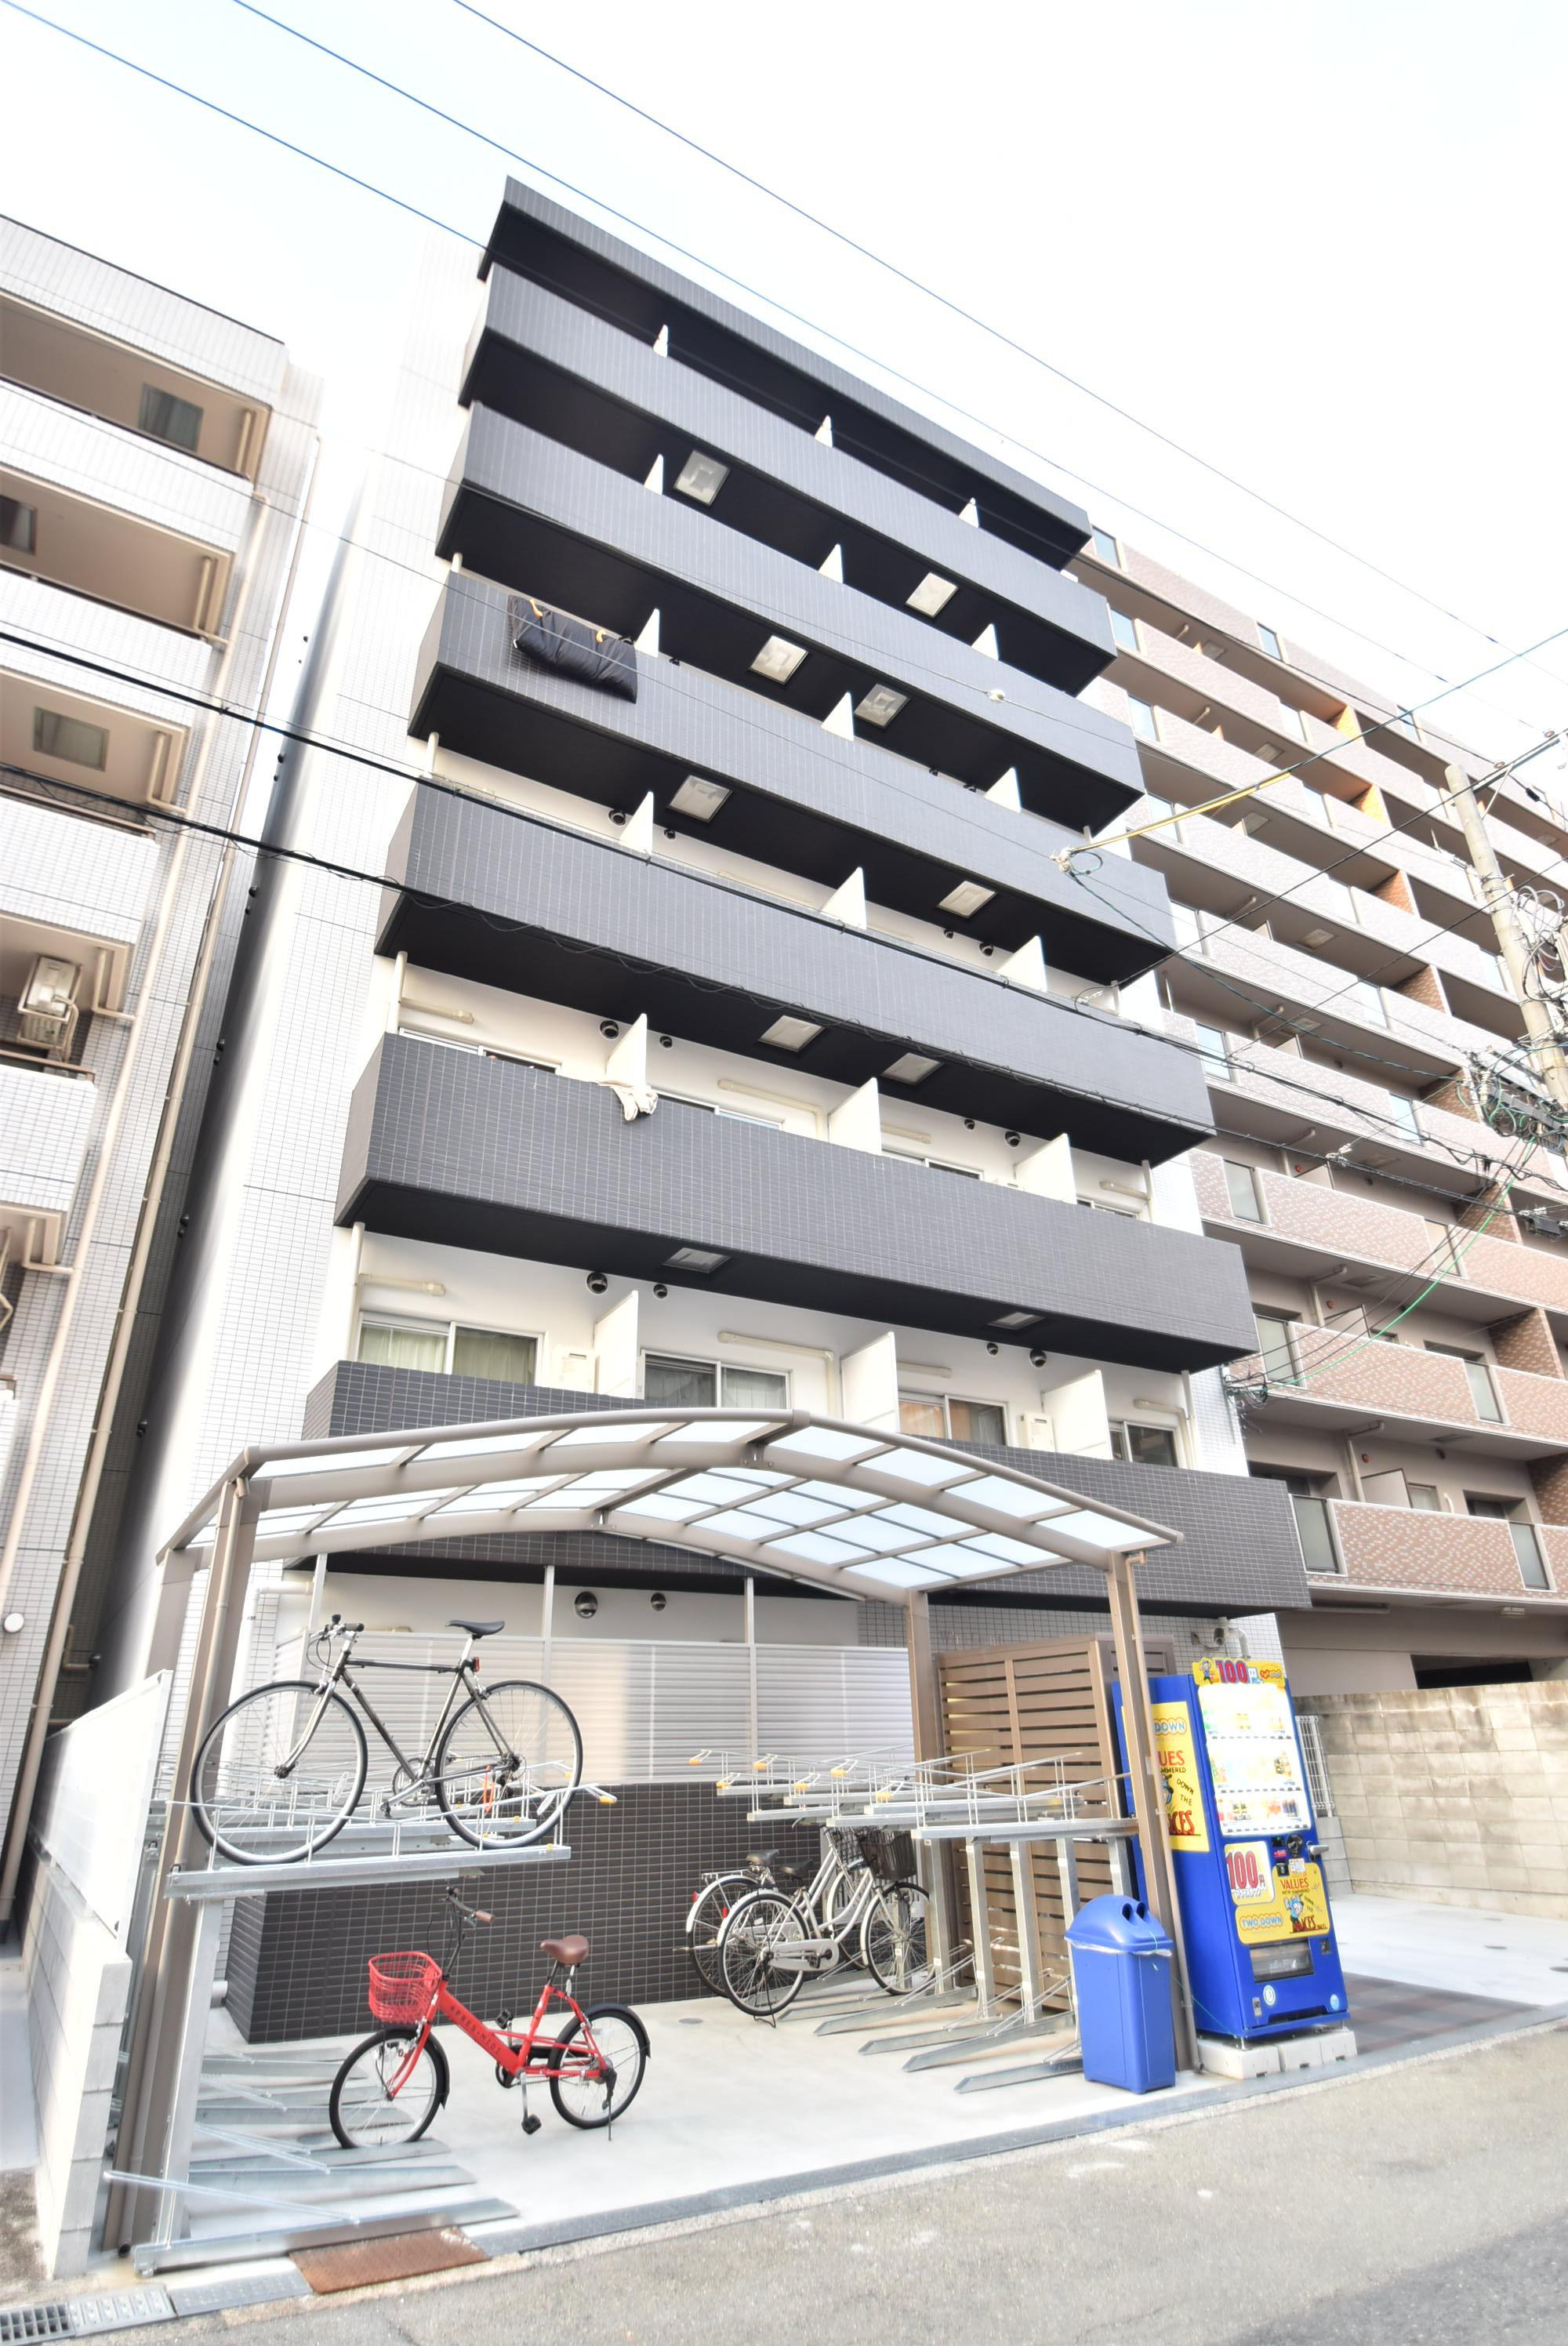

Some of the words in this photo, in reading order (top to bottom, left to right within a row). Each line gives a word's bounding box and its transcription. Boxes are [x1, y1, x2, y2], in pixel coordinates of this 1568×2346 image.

[1154, 1721, 1185, 1734] DOWN
[1158, 1750, 1185, 1767] UES
[1177, 1778, 1194, 1795] DOWN
[1180, 1794, 1192, 1807] THE
[1280, 1877, 1309, 1890] VALUES
[1242, 1918, 1258, 1927] TWO
[1261, 1916, 1282, 1925] DOWN
